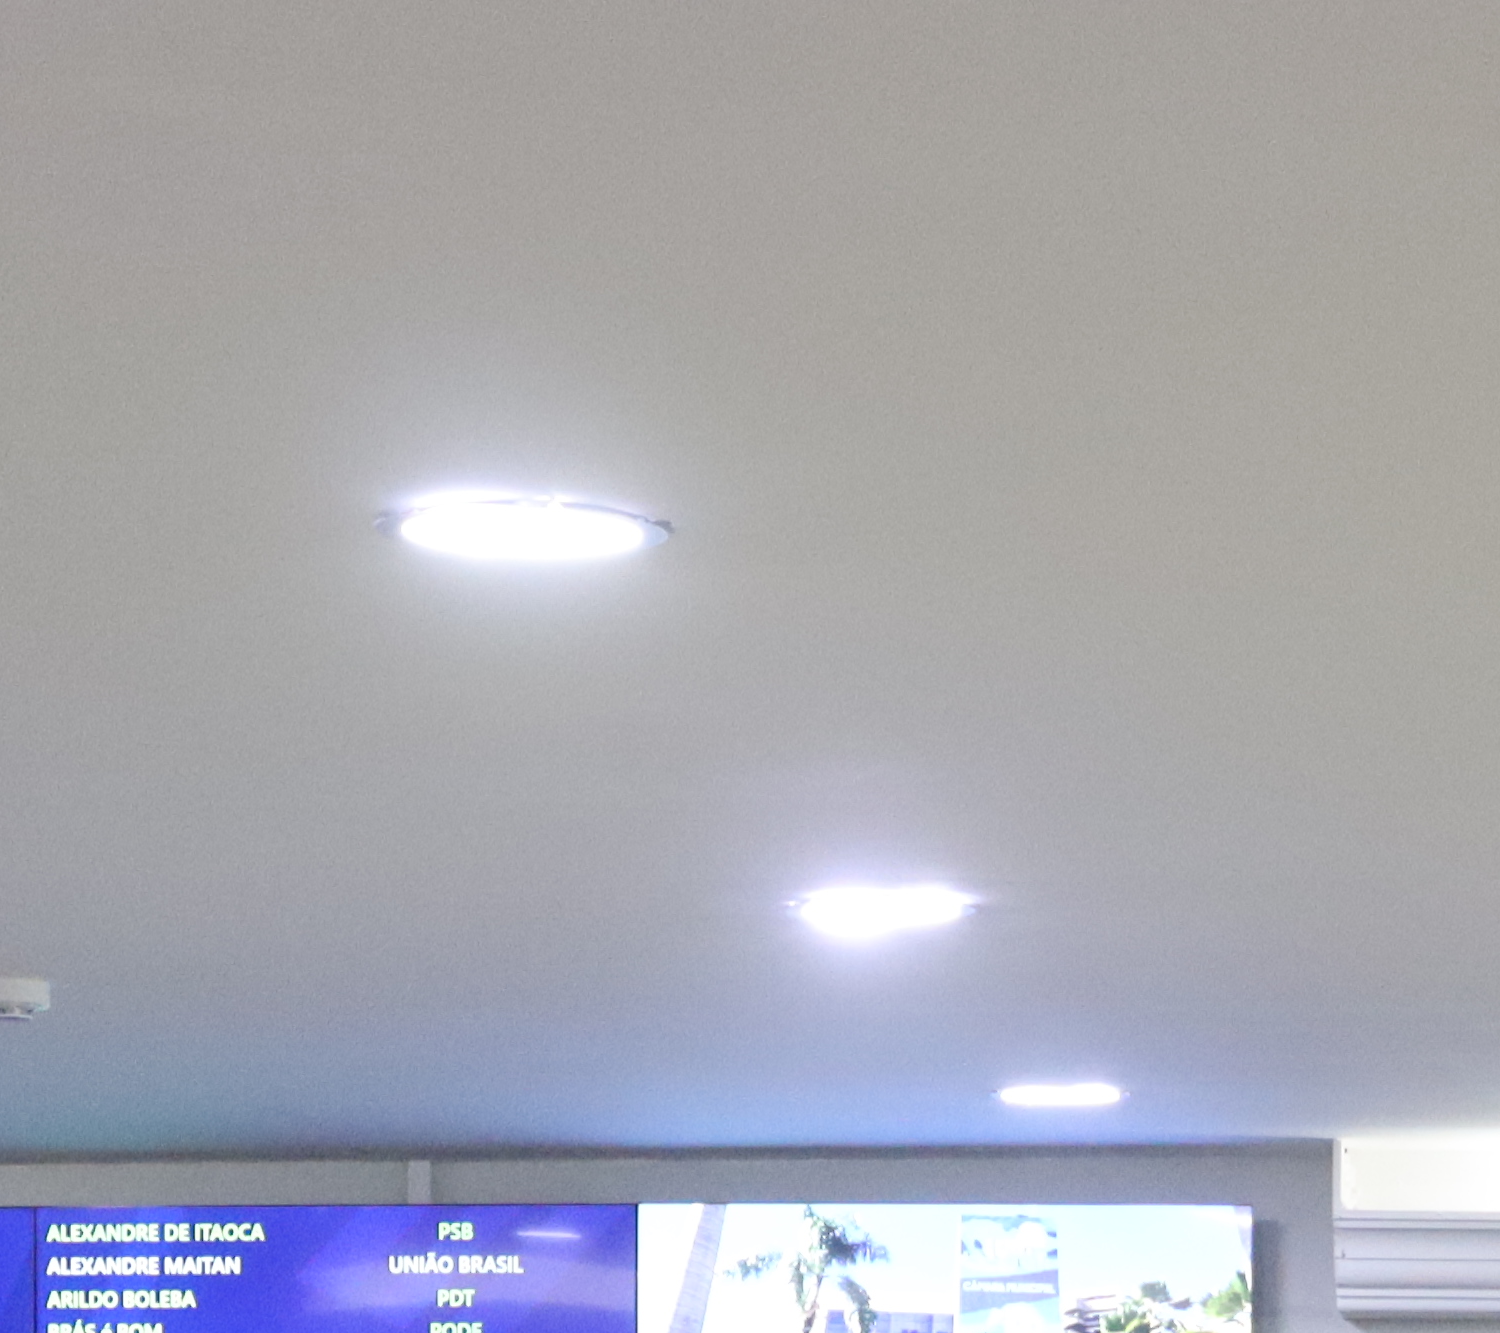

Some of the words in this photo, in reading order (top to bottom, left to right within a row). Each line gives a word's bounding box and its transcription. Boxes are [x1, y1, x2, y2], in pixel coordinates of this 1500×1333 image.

[46, 1222, 161, 1244] ALEXANDRE
[163, 1222, 191, 1243] DE
[194, 1222, 266, 1243] ITAOCA
[438, 1221, 474, 1242] PSB
[45, 1255, 161, 1277] ALEXANDRE
[163, 1255, 242, 1276] MAITAN
[388, 1251, 456, 1275] UNIÃO
[458, 1255, 524, 1275] BRASIL
[46, 1289, 120, 1310] ARILDO
[122, 1289, 197, 1310] BOLEBA
[436, 1288, 475, 1308] PDT
